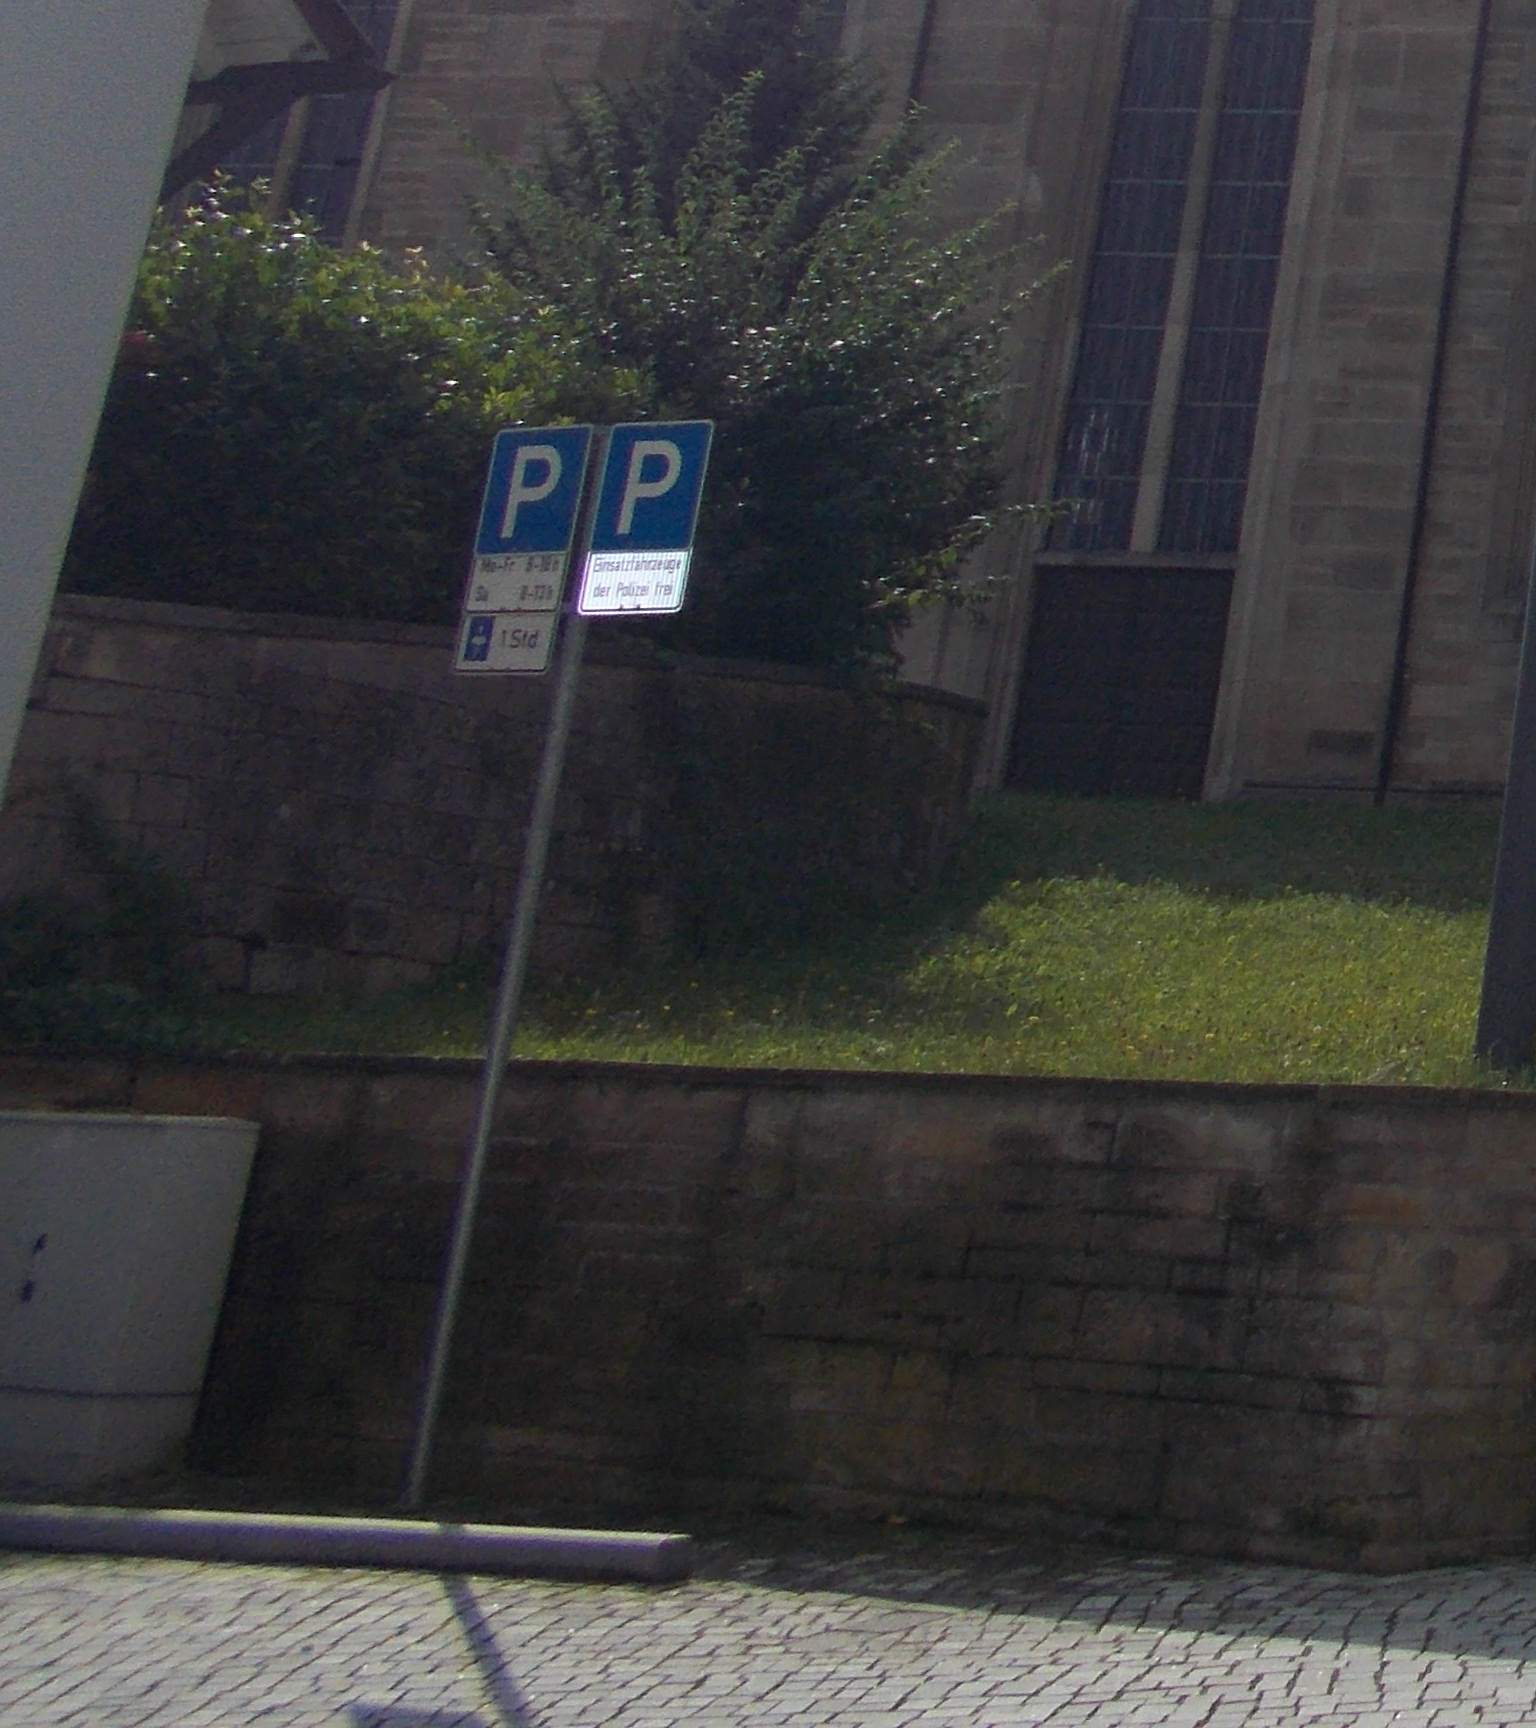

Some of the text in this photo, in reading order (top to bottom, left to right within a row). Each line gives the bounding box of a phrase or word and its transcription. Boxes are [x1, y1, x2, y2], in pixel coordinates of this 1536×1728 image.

[499, 444, 564, 539] P
[616, 440, 683, 535] P
[593, 556, 682, 574] Einsatzfahrzeuge
[593, 580, 673, 598] der Polizei frei
